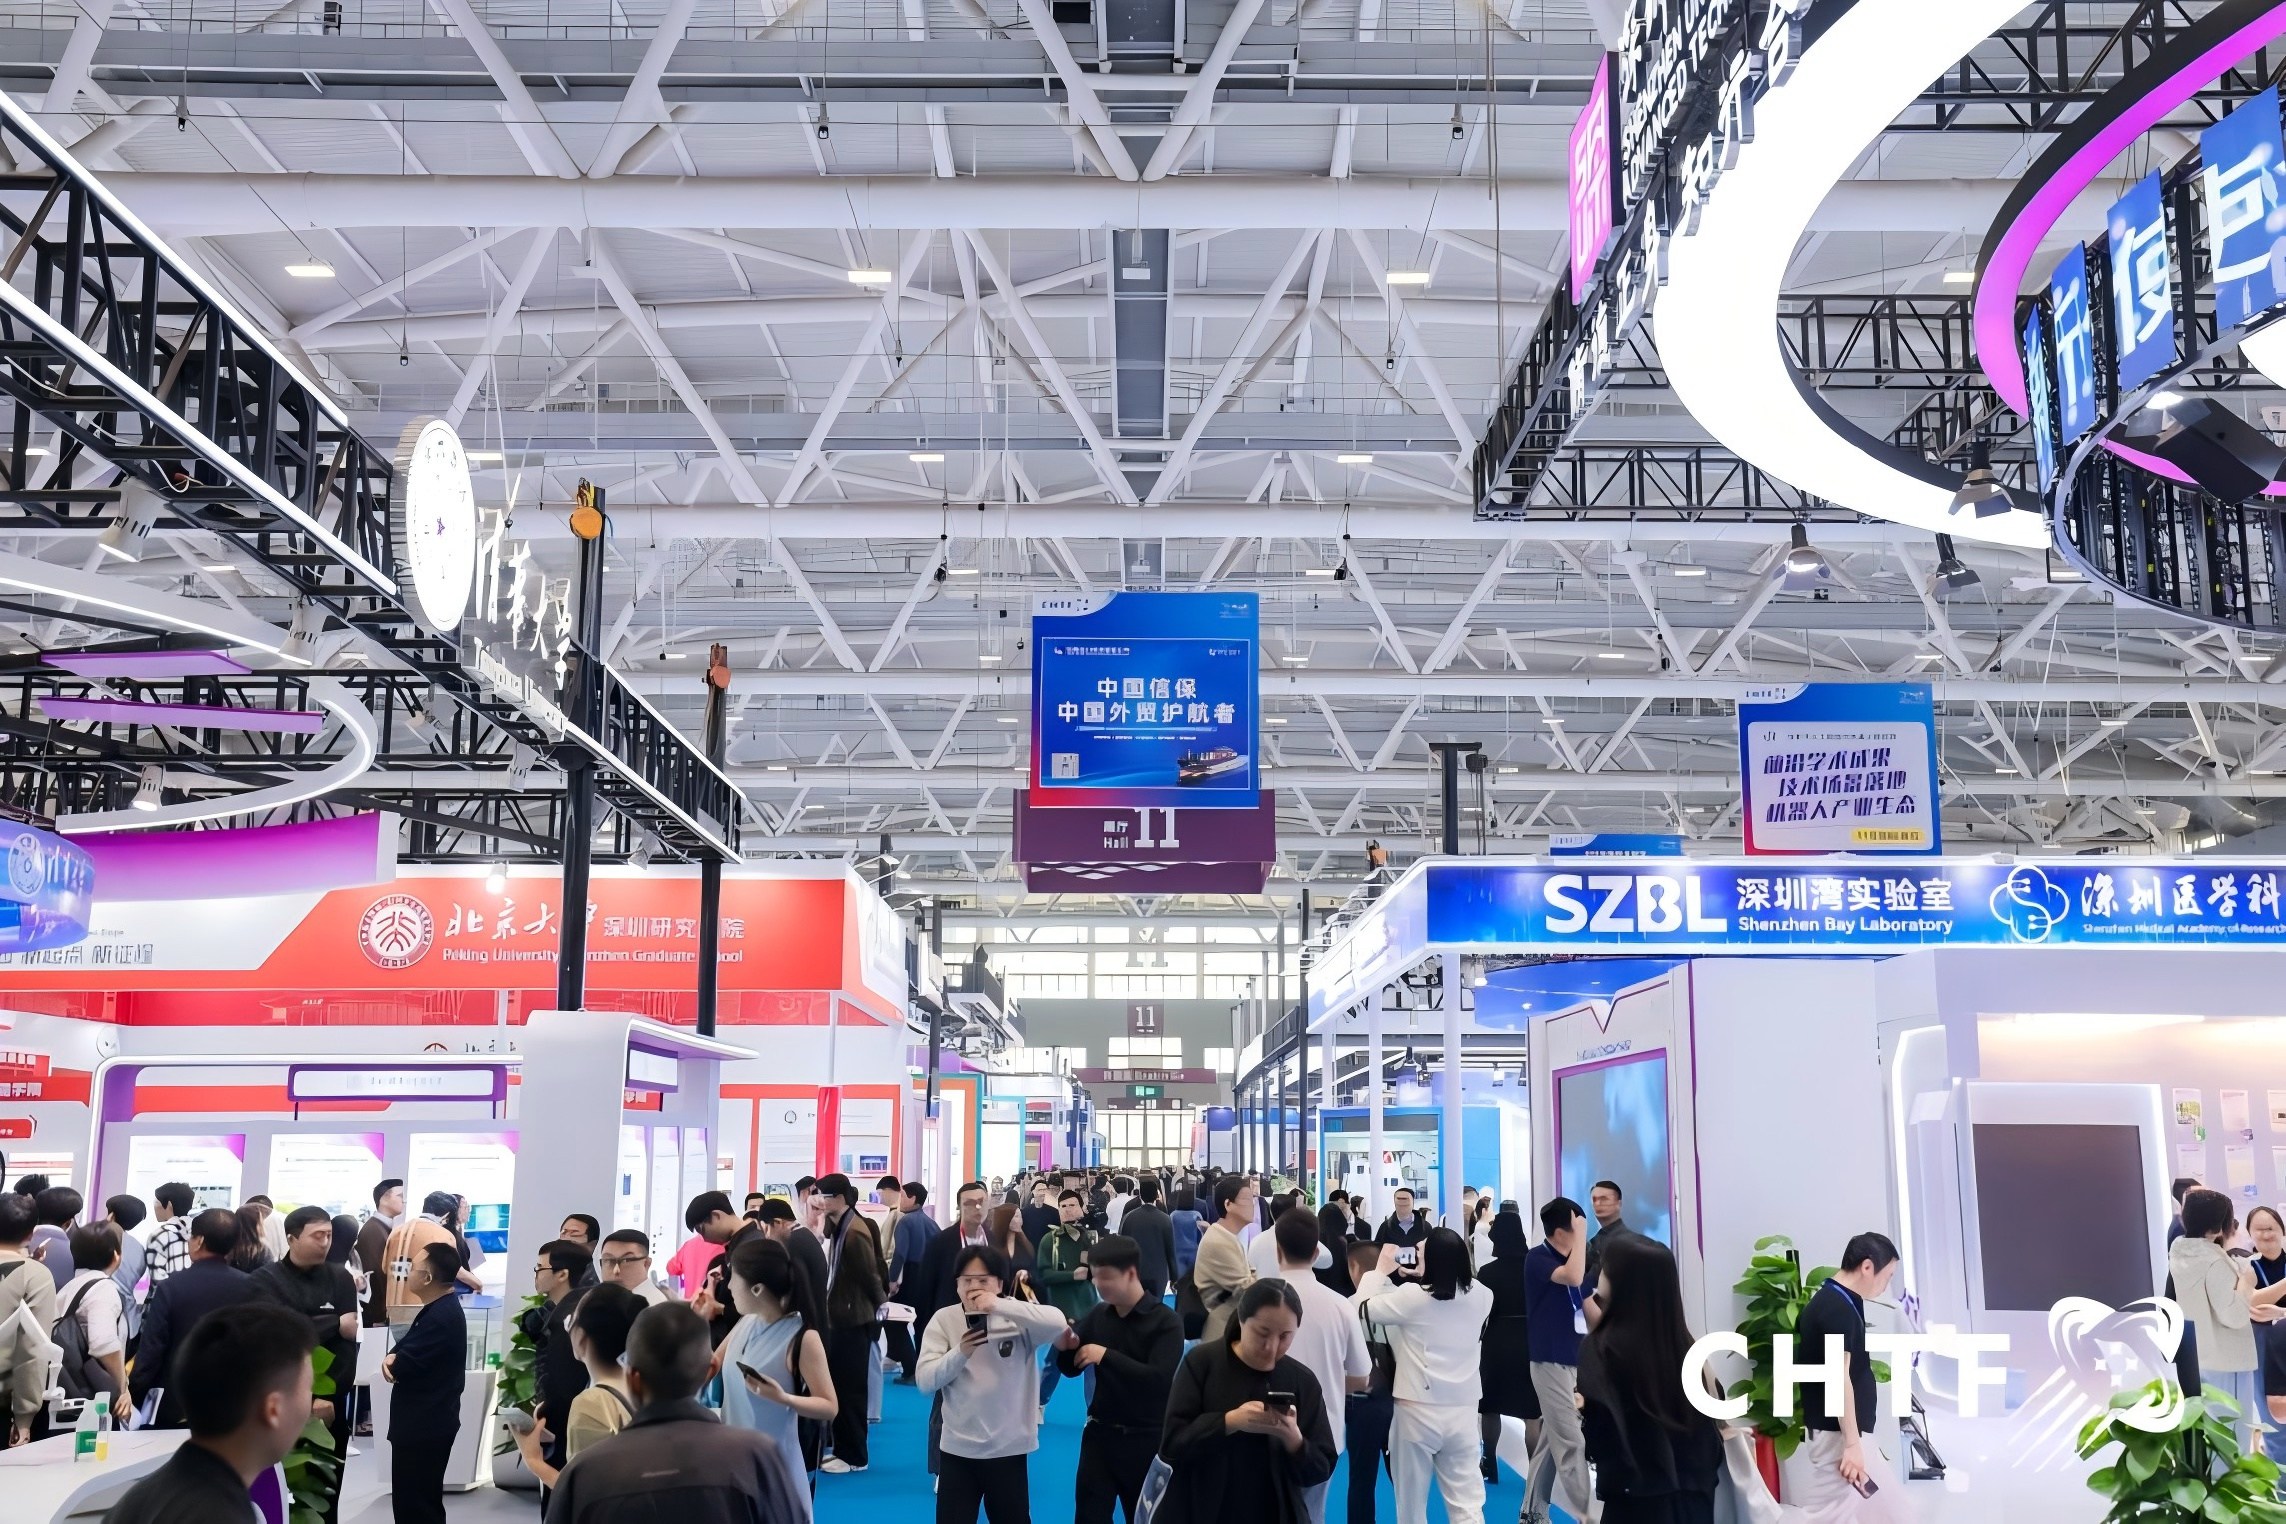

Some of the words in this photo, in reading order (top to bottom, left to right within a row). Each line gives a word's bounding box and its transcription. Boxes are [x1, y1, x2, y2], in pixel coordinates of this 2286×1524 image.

[1097, 676, 1198, 700] 中国信保
[1057, 700, 1236, 725] 中国外贸护航者
[1763, 747, 1892, 775] 前沿学术成果
[1778, 770, 1908, 798] 技术场景落地
[1765, 794, 1917, 824] 机器人产业生态
[1134, 806, 1180, 848] 11
[1103, 836, 1129, 849] Hall
[1543, 874, 1728, 933] SZBL
[1736, 877, 1955, 911] 深圳湾实验室
[603, 916, 745, 939] 深圳研究院
[1738, 916, 1820, 932] Shenzhen
[1824, 916, 1856, 935] Bay
[1860, 916, 1953, 935] Laboratory
[442, 947, 488, 964] Peking
[492, 947, 560, 964] University
[632, 950, 697, 963] Graduate
[1136, 1006, 1156, 1027] 11
